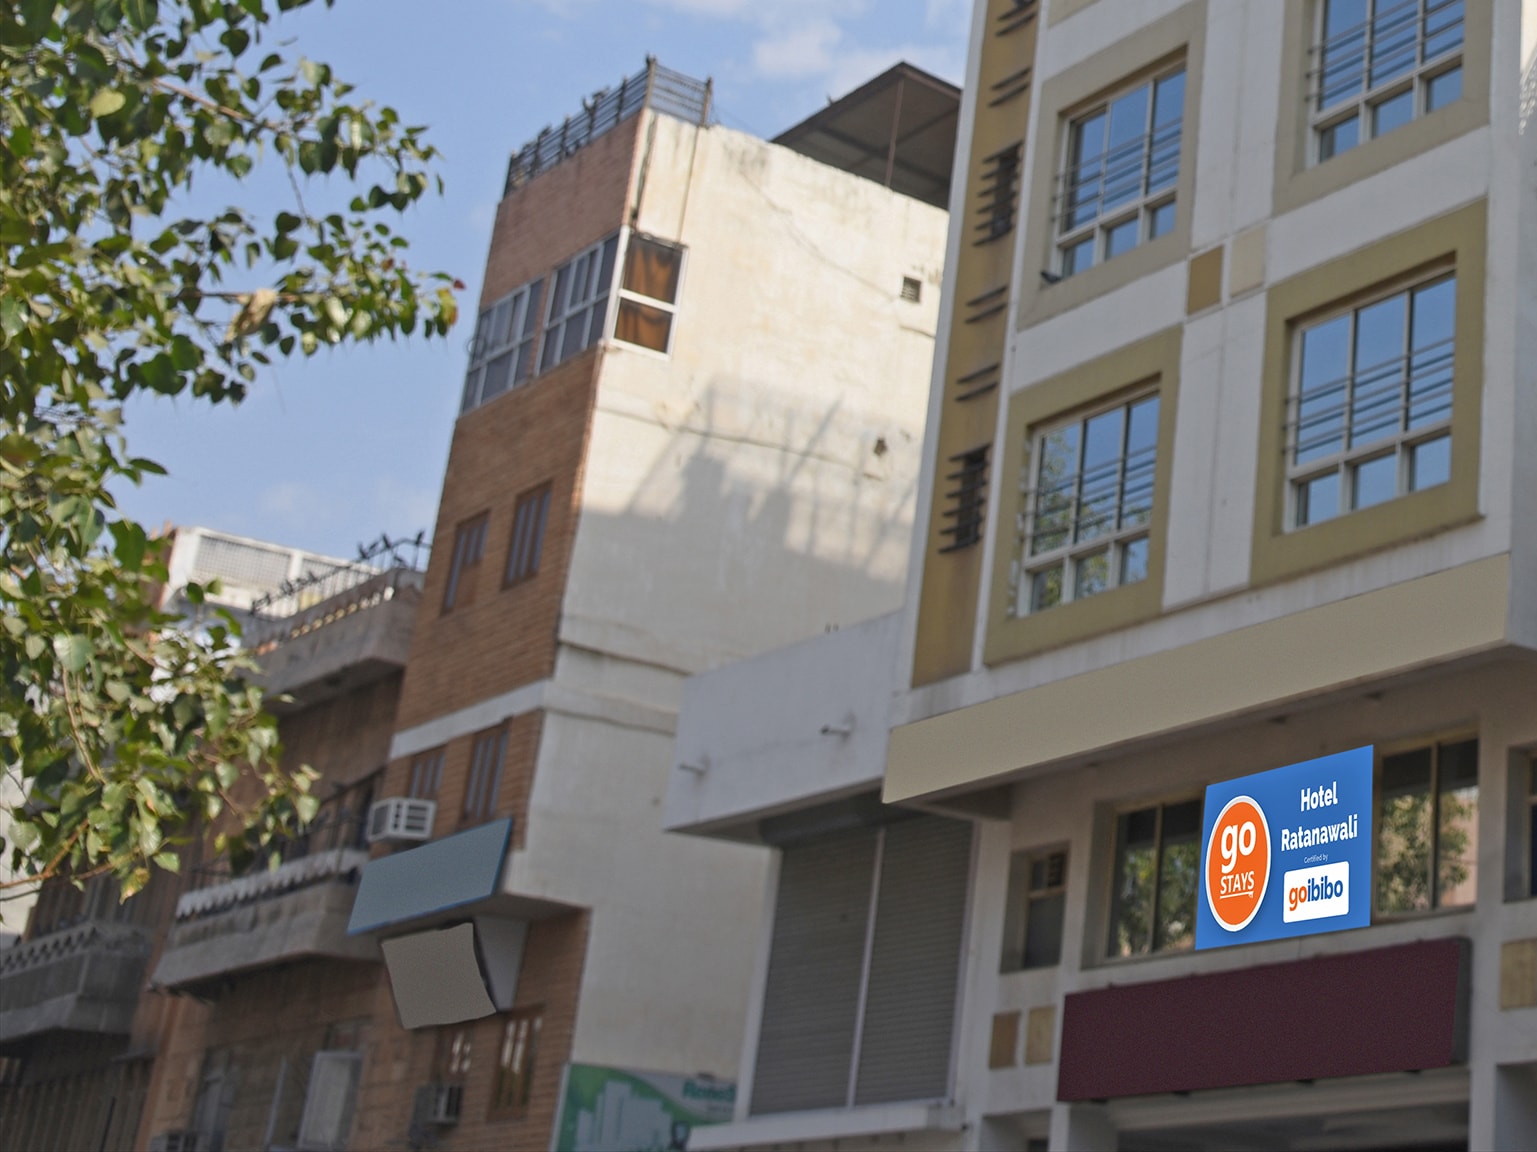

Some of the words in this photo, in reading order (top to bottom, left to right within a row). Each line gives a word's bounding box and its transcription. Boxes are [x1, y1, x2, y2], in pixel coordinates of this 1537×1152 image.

[1301, 781, 1338, 812] Hotel
[1221, 821, 1256, 874] go
[1281, 814, 1358, 851] Ratanawali
[1220, 870, 1255, 895] STAYS
[1289, 875, 1343, 911] goibibo
